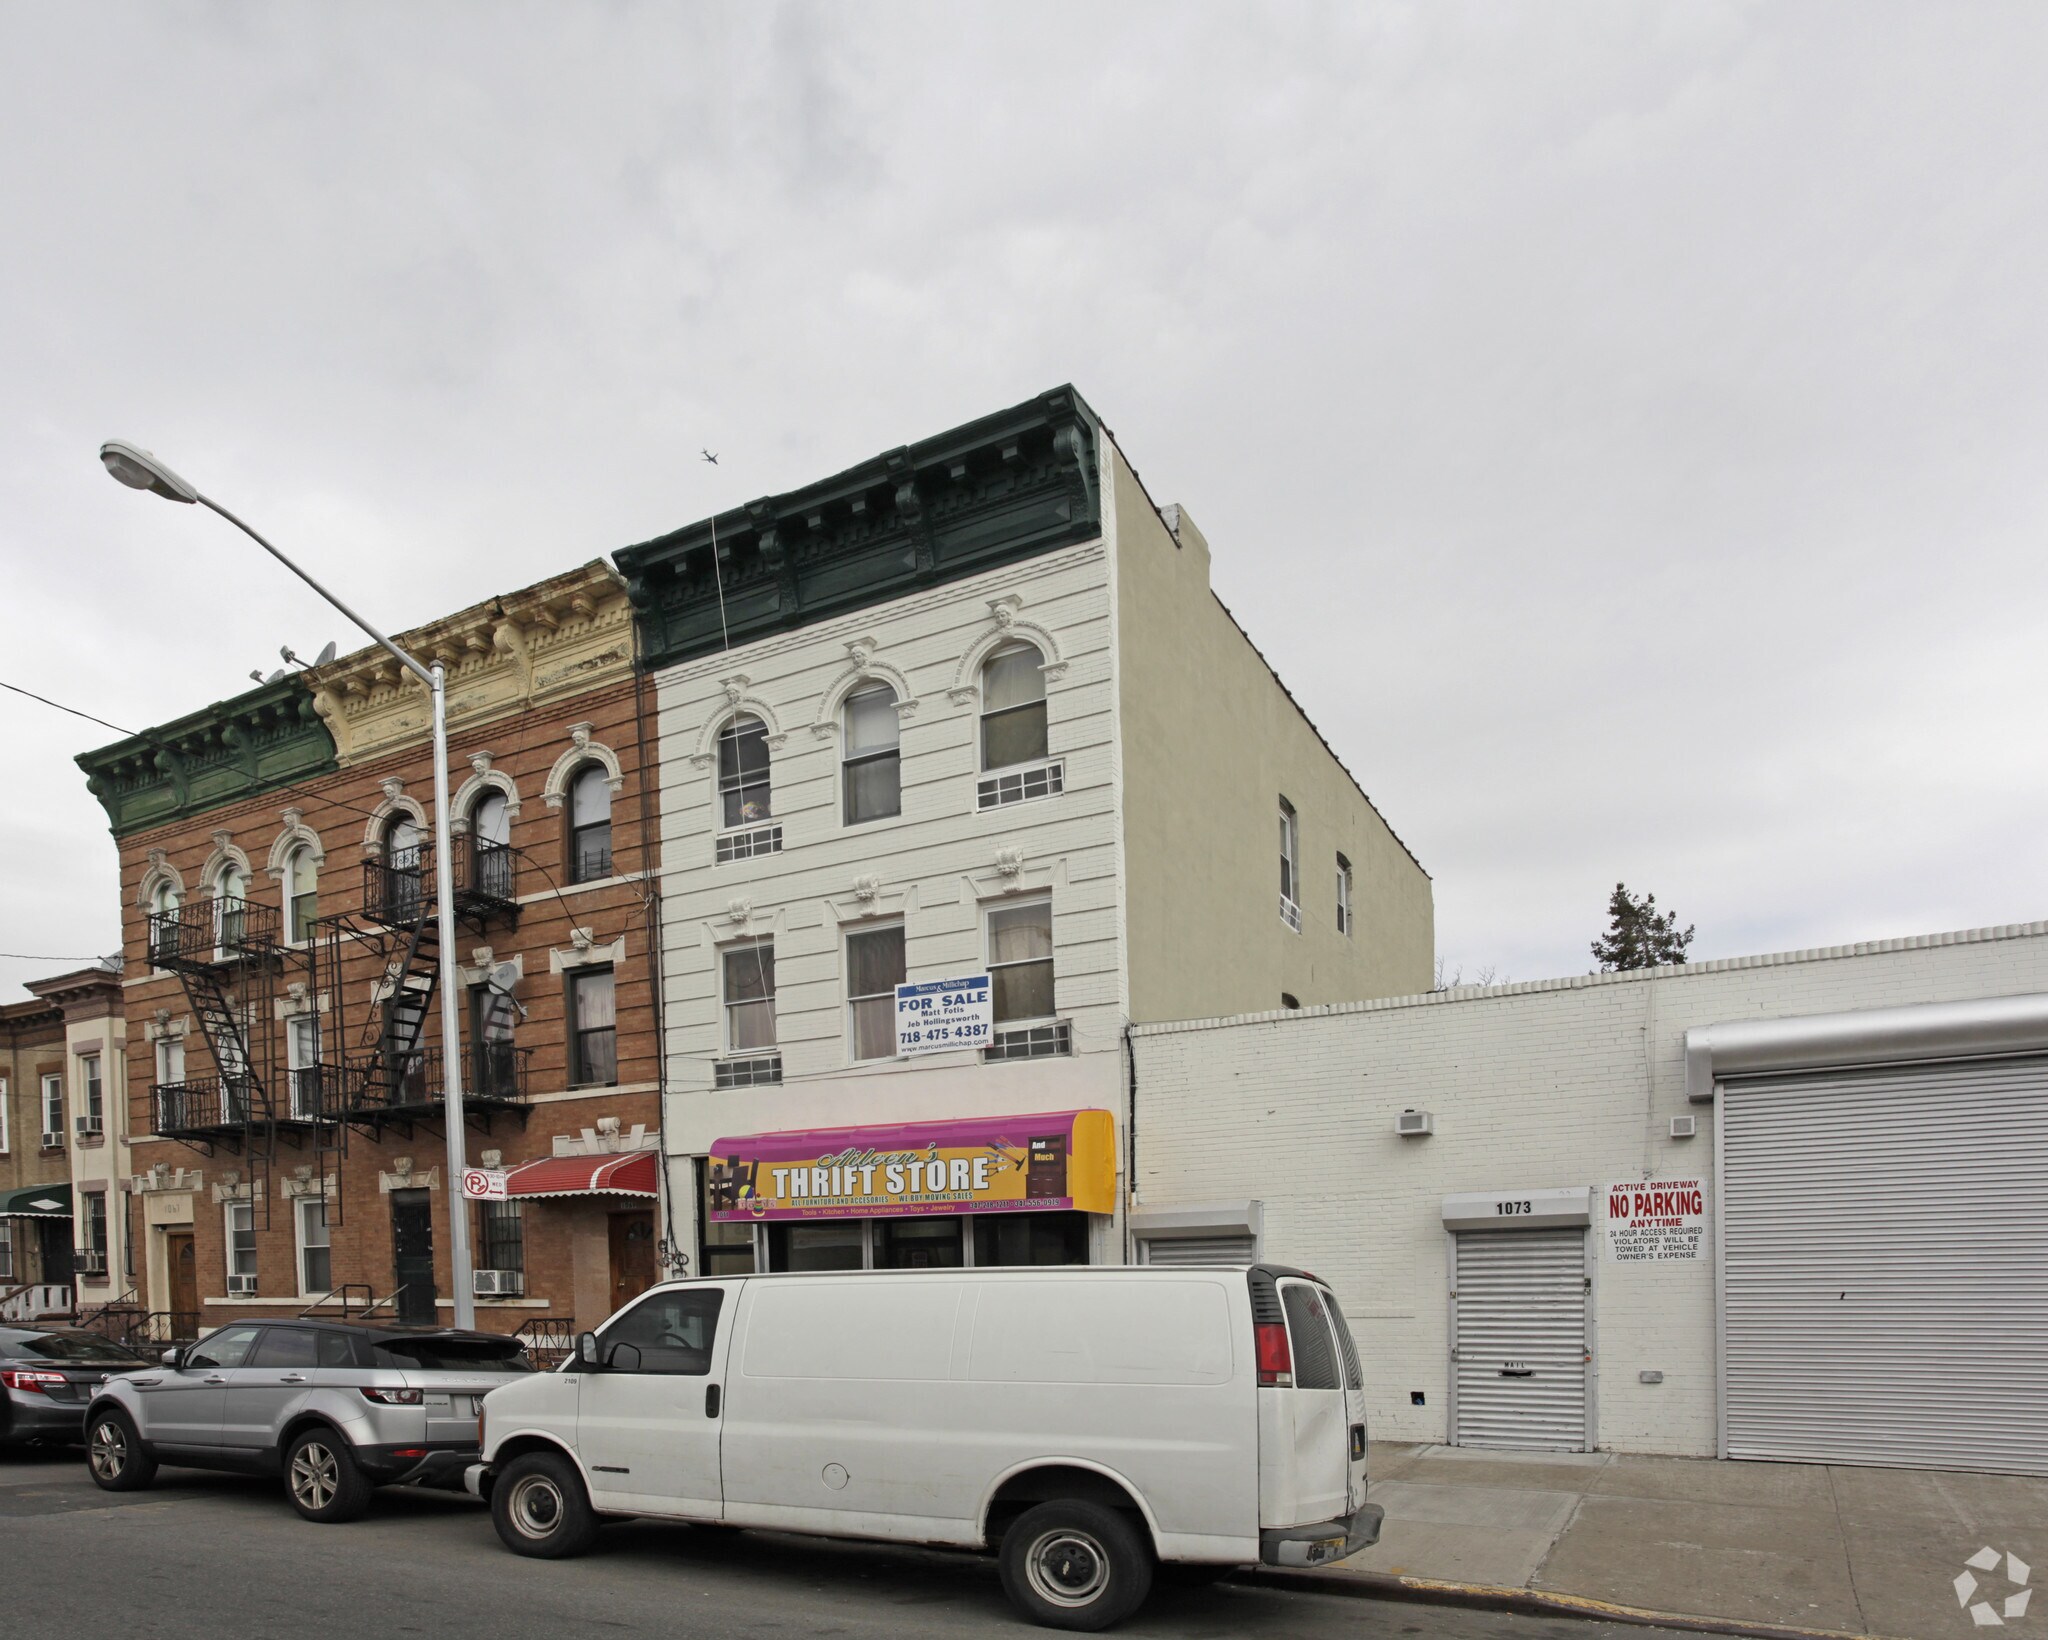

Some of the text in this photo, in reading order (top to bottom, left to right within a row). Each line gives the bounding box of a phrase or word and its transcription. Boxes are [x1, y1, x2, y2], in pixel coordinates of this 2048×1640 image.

[916, 980, 970, 993] Marcus & Millichap
[899, 991, 988, 1012] FOR SALE
[944, 1006, 964, 1015] Fotis
[923, 1014, 980, 1026] Hollingsworth
[900, 1024, 988, 1044] 718-475-4387
[901, 1039, 989, 1053] www.marcusmillichap.com
[1032, 1141, 1046, 1149] And
[1034, 1153, 1054, 1161] Much
[772, 1157, 990, 1198] THRIFT STORE
[1612, 1180, 1699, 1192] ACTIVE DRIVEWAY
[803, 1197, 835, 1206] FURNITURE
[837, 1197, 849, 1205] AND
[850, 1195, 889, 1204] ACCESORIES
[899, 1194, 908, 1202] WE
[910, 1194, 922, 1202] BUY
[925, 1193, 951, 1201] MOVING
[953, 1192, 973, 1200] SALES
[1610, 1190, 1702, 1218] NO PARKING
[869, 1206, 904, 1214] Appliances
[910, 1205, 924, 1213] Toys
[930, 1204, 956, 1212] Jewelry
[1496, 1201, 1531, 1215] 1073
[1630, 1218, 1683, 1228] ANYTIME
[1620, 1229, 1637, 1237] HOUR
[1640, 1228, 1667, 1236] ACCESS
[1669, 1227, 1703, 1235] REQUIRED
[1614, 1237, 1660, 1245] VIOLATORS
[1664, 1236, 1684, 1244] WILL
[1617, 1253, 1654, 1261] OWNER'S
[1504, 1361, 1525, 1369] MAIL
